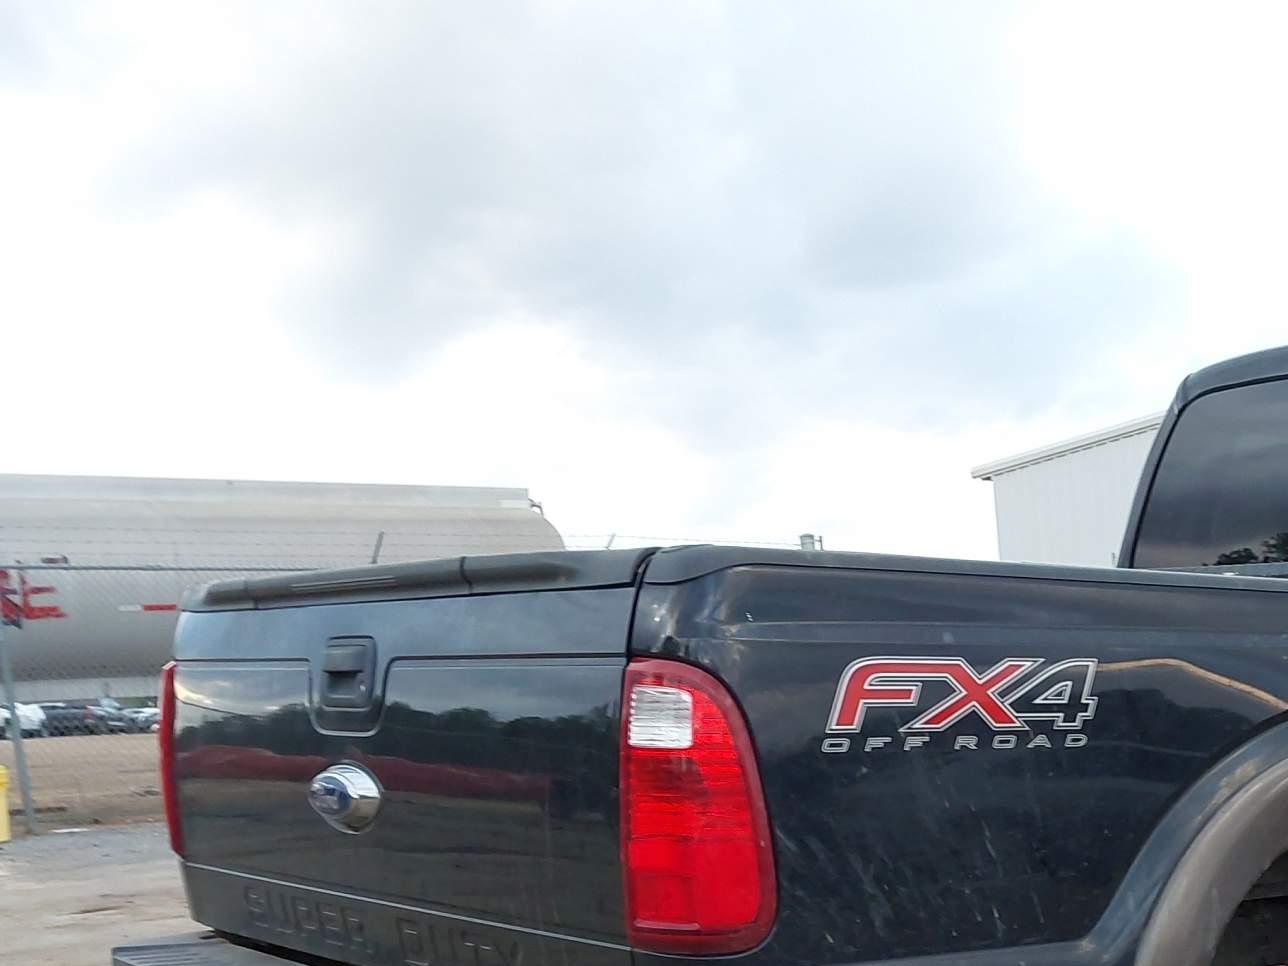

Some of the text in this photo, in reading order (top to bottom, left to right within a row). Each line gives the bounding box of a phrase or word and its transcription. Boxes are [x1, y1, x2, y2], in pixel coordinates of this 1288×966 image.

[825, 655, 1098, 733] FX4
[820, 733, 1089, 753] OFF ROAD
[246, 889, 375, 956] SUPER
